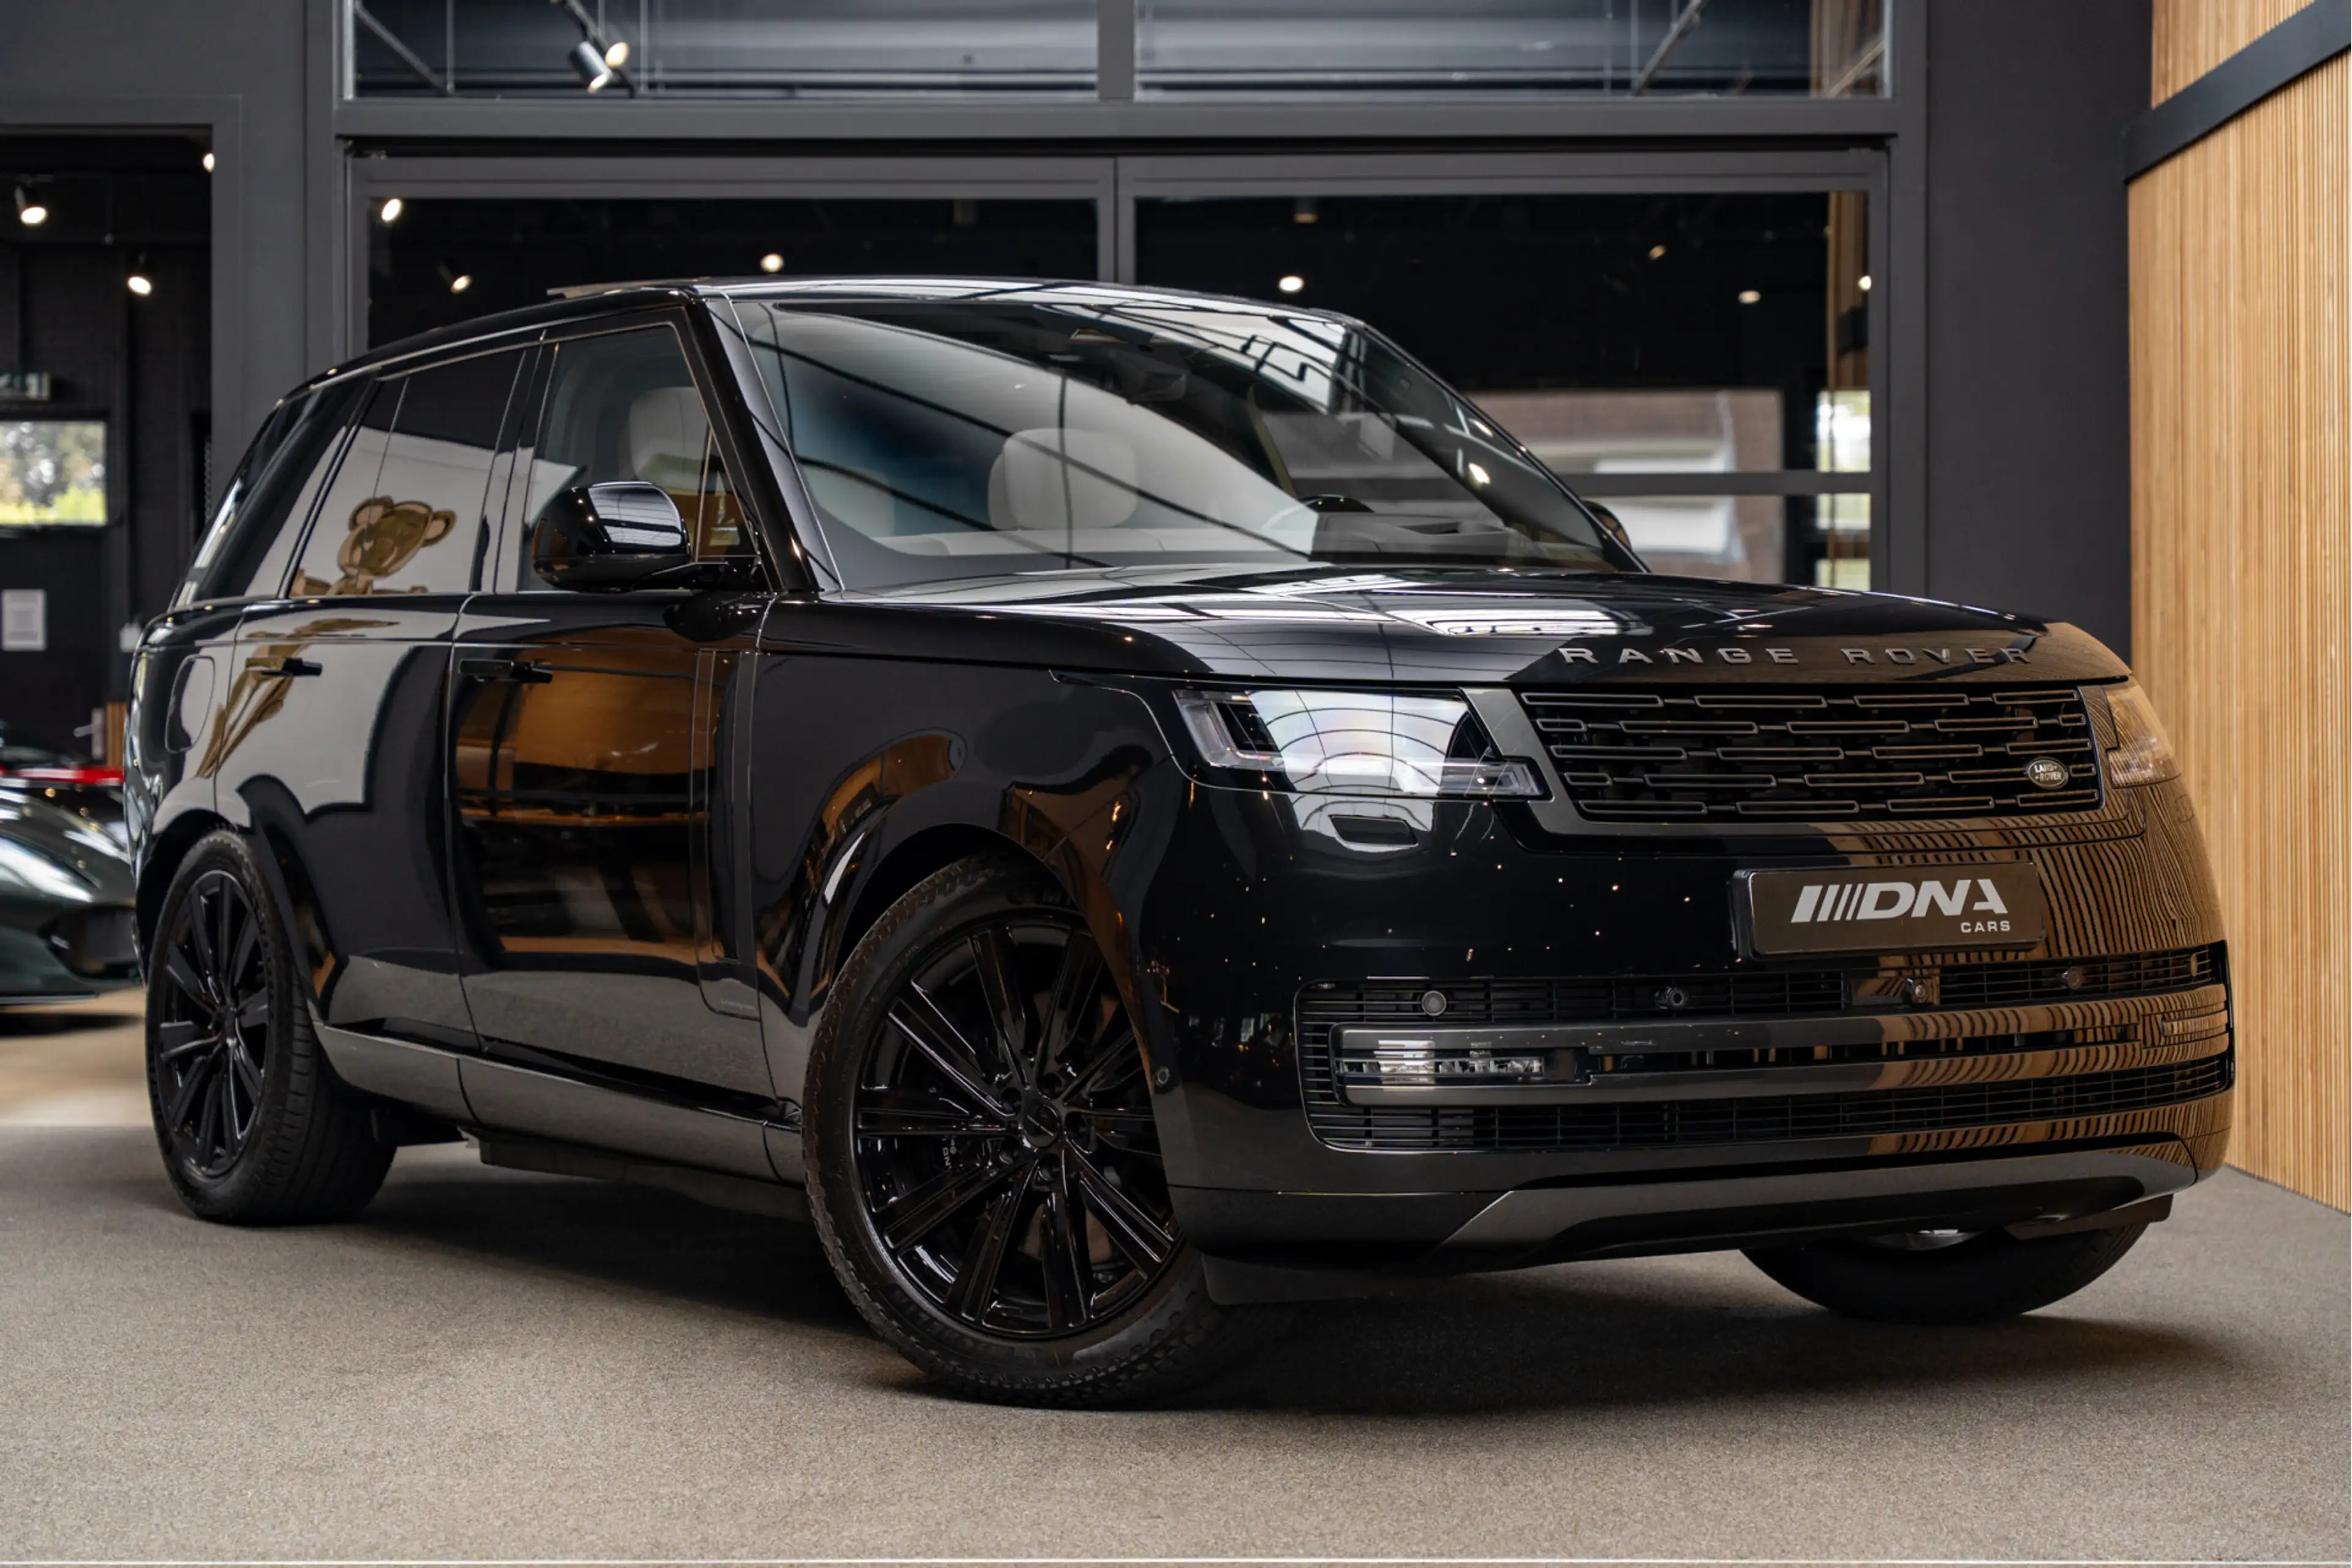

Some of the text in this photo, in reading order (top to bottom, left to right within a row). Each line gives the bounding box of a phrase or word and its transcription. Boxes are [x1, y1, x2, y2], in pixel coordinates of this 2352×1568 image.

[1558, 647, 2031, 665] RANGE ROVER
[2034, 763, 2054, 773] LAND
[2040, 771, 2062, 782] ROVER
[1856, 878, 2009, 920] DNA
[1960, 920, 2011, 933] CARS
